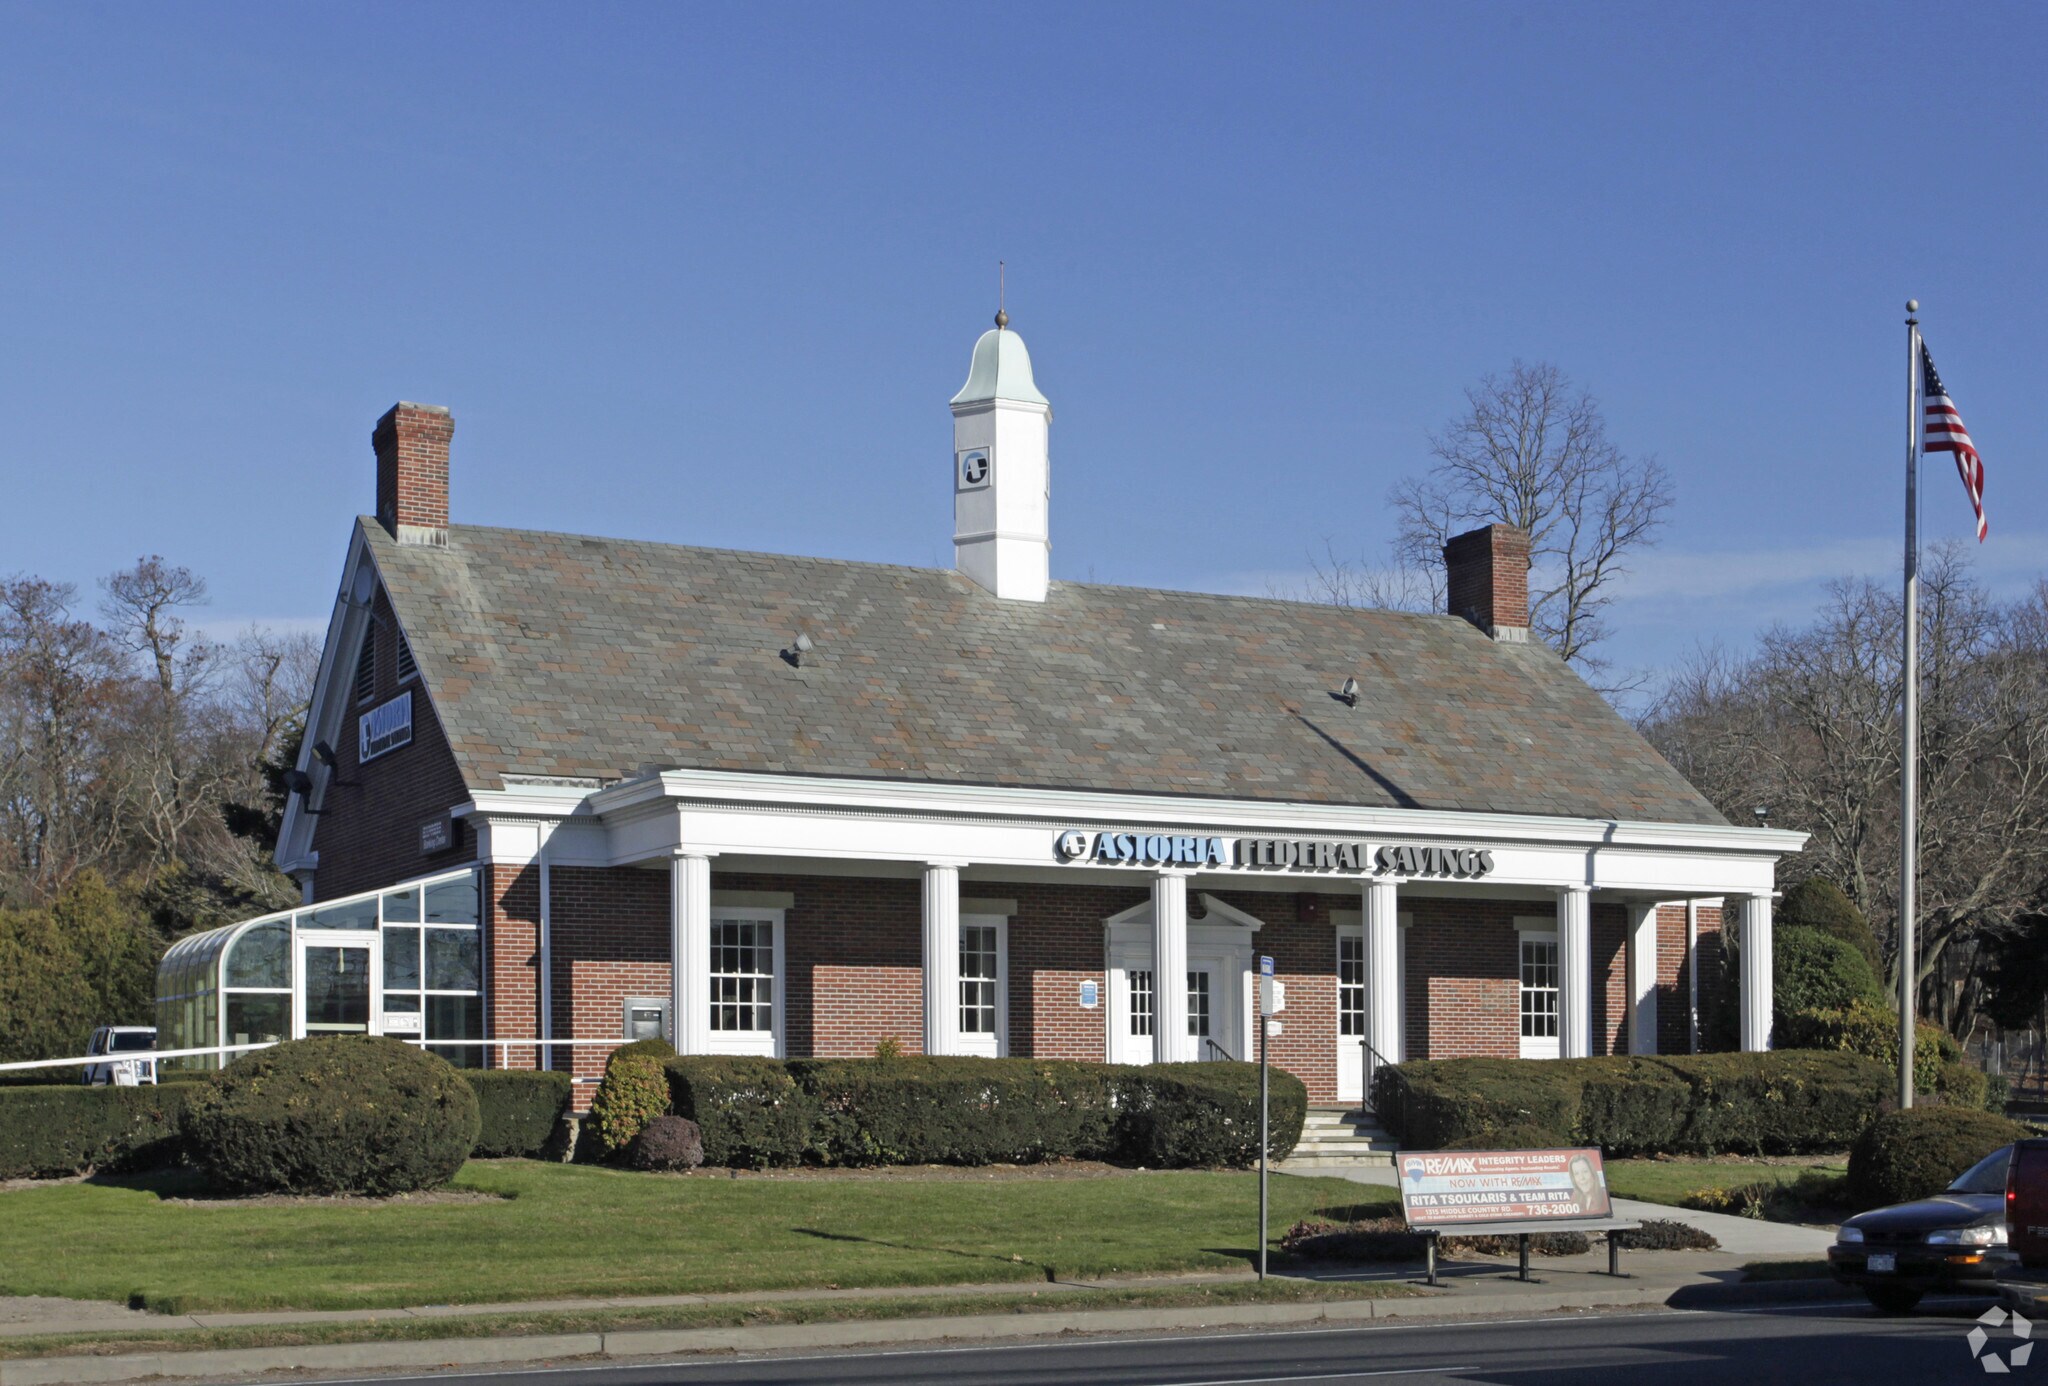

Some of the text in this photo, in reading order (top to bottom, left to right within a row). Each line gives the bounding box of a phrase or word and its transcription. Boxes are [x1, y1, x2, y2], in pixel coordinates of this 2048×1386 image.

[1097, 832, 1227, 863] ASTORIA
[1240, 839, 1371, 868] FEDERAL
[1382, 845, 1494, 874] SAVINGS
[1425, 1157, 1478, 1175] RE/MAX
[1479, 1154, 1566, 1165] INTEGRITY LEADERS
[1449, 1176, 1542, 1188] NOW WITH RE/MAX
[1410, 1191, 1571, 1206] RITA TSOUKARIS & TEAM RITA
[1440, 1207, 1467, 1215] MIDDLE
[1467, 1206, 1500, 1214] COUNTRY
[1526, 1203, 1580, 1216] 736-2000
